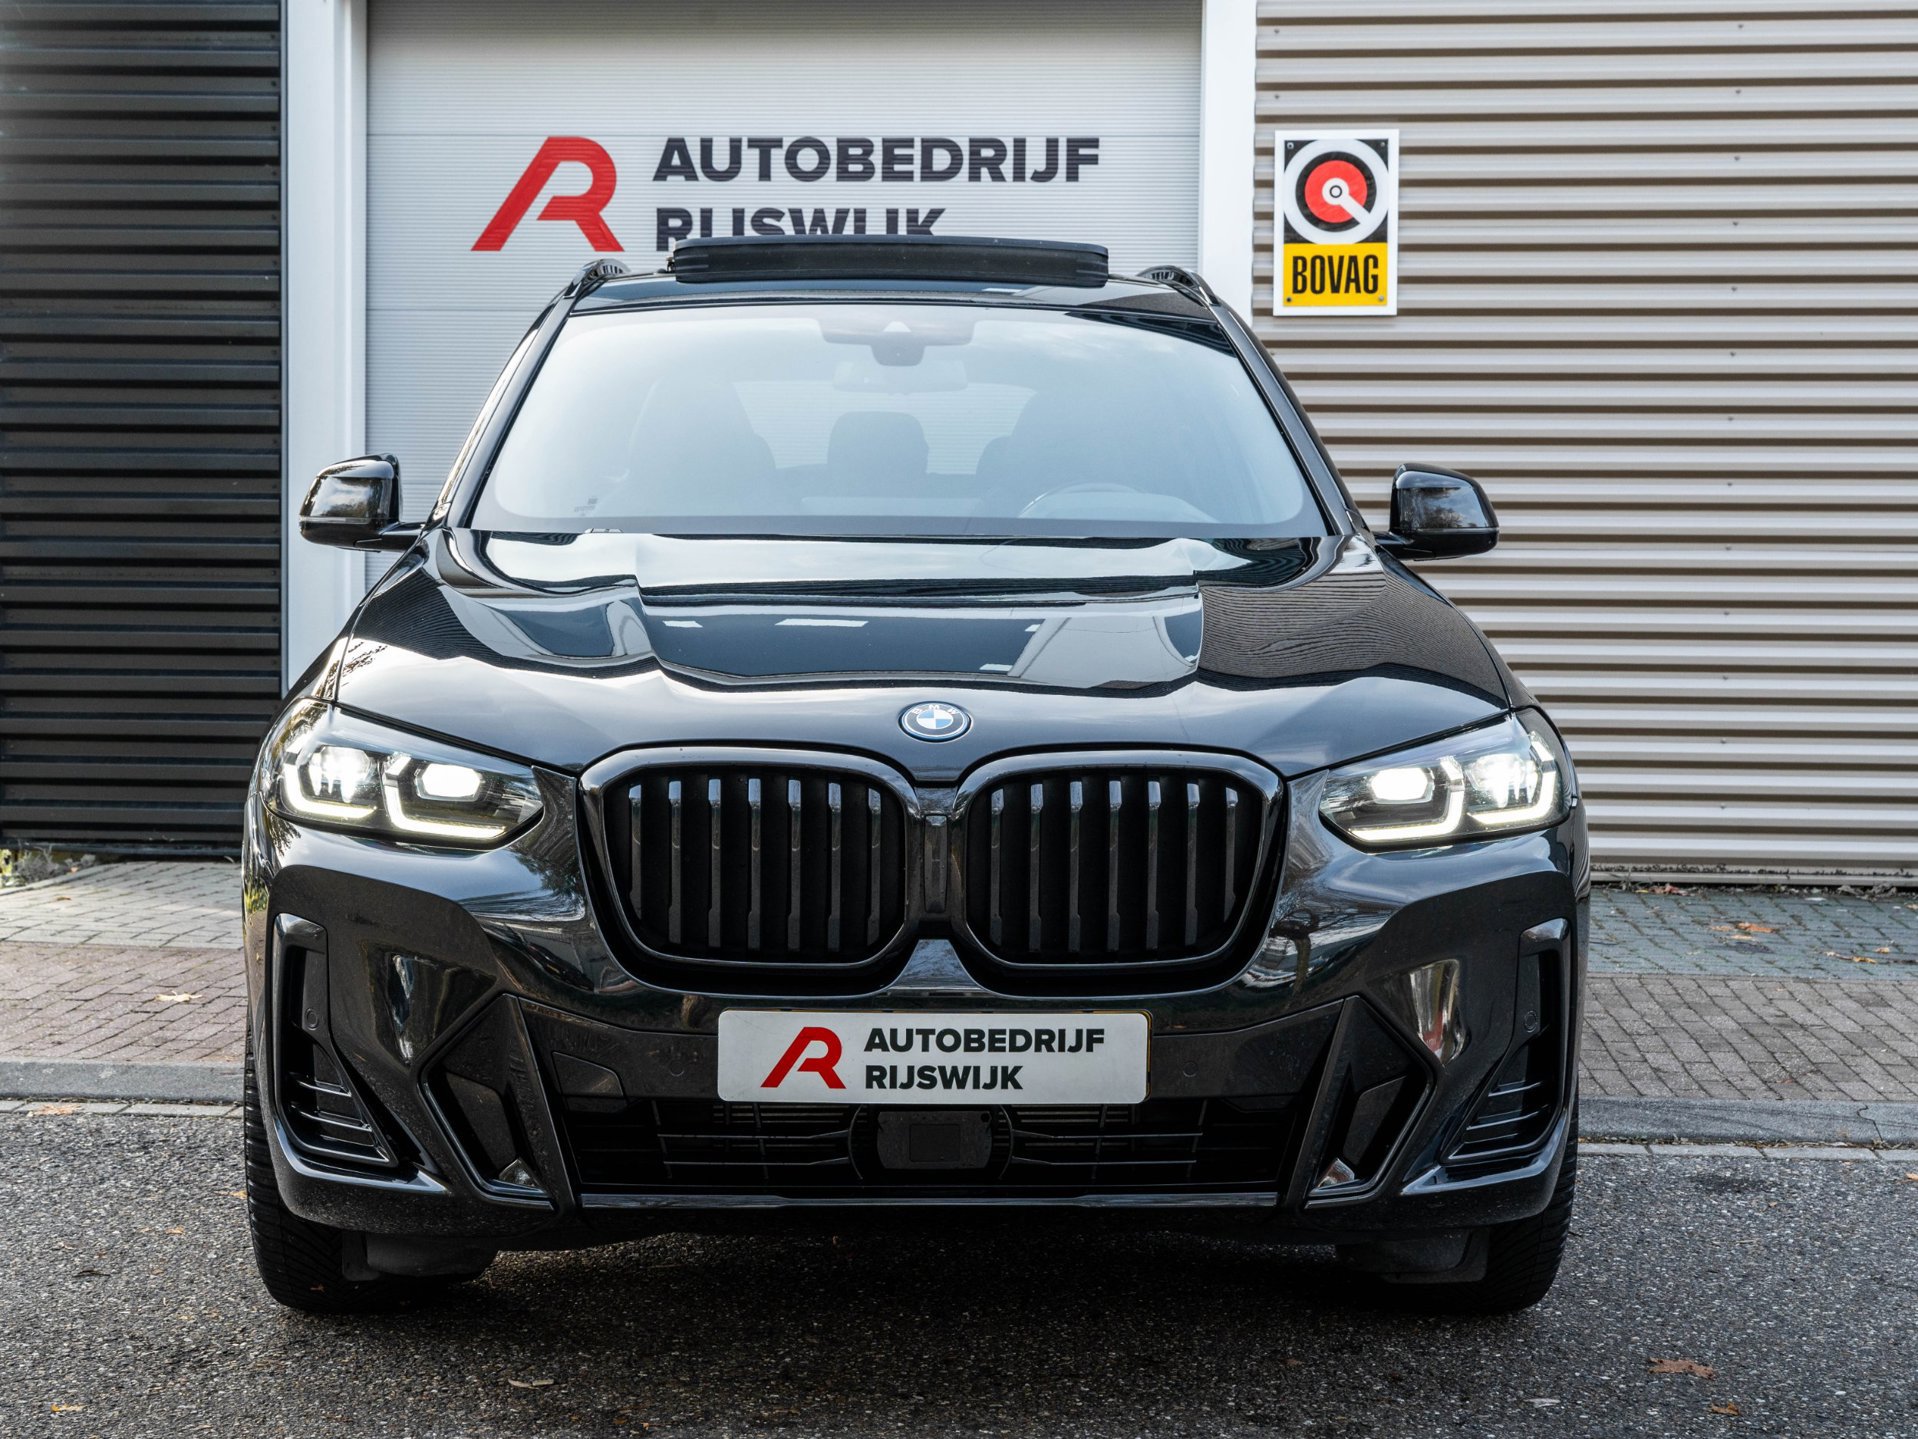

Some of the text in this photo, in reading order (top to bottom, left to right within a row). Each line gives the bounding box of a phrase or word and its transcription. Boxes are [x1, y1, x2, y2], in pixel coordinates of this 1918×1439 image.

[652, 136, 1101, 183] AUTOBEDRIJF
[1292, 254, 1379, 294] BOVAG
[863, 1027, 1105, 1053] AUTOBEDRIJF
[865, 1064, 1024, 1090] RIJSWIJK
